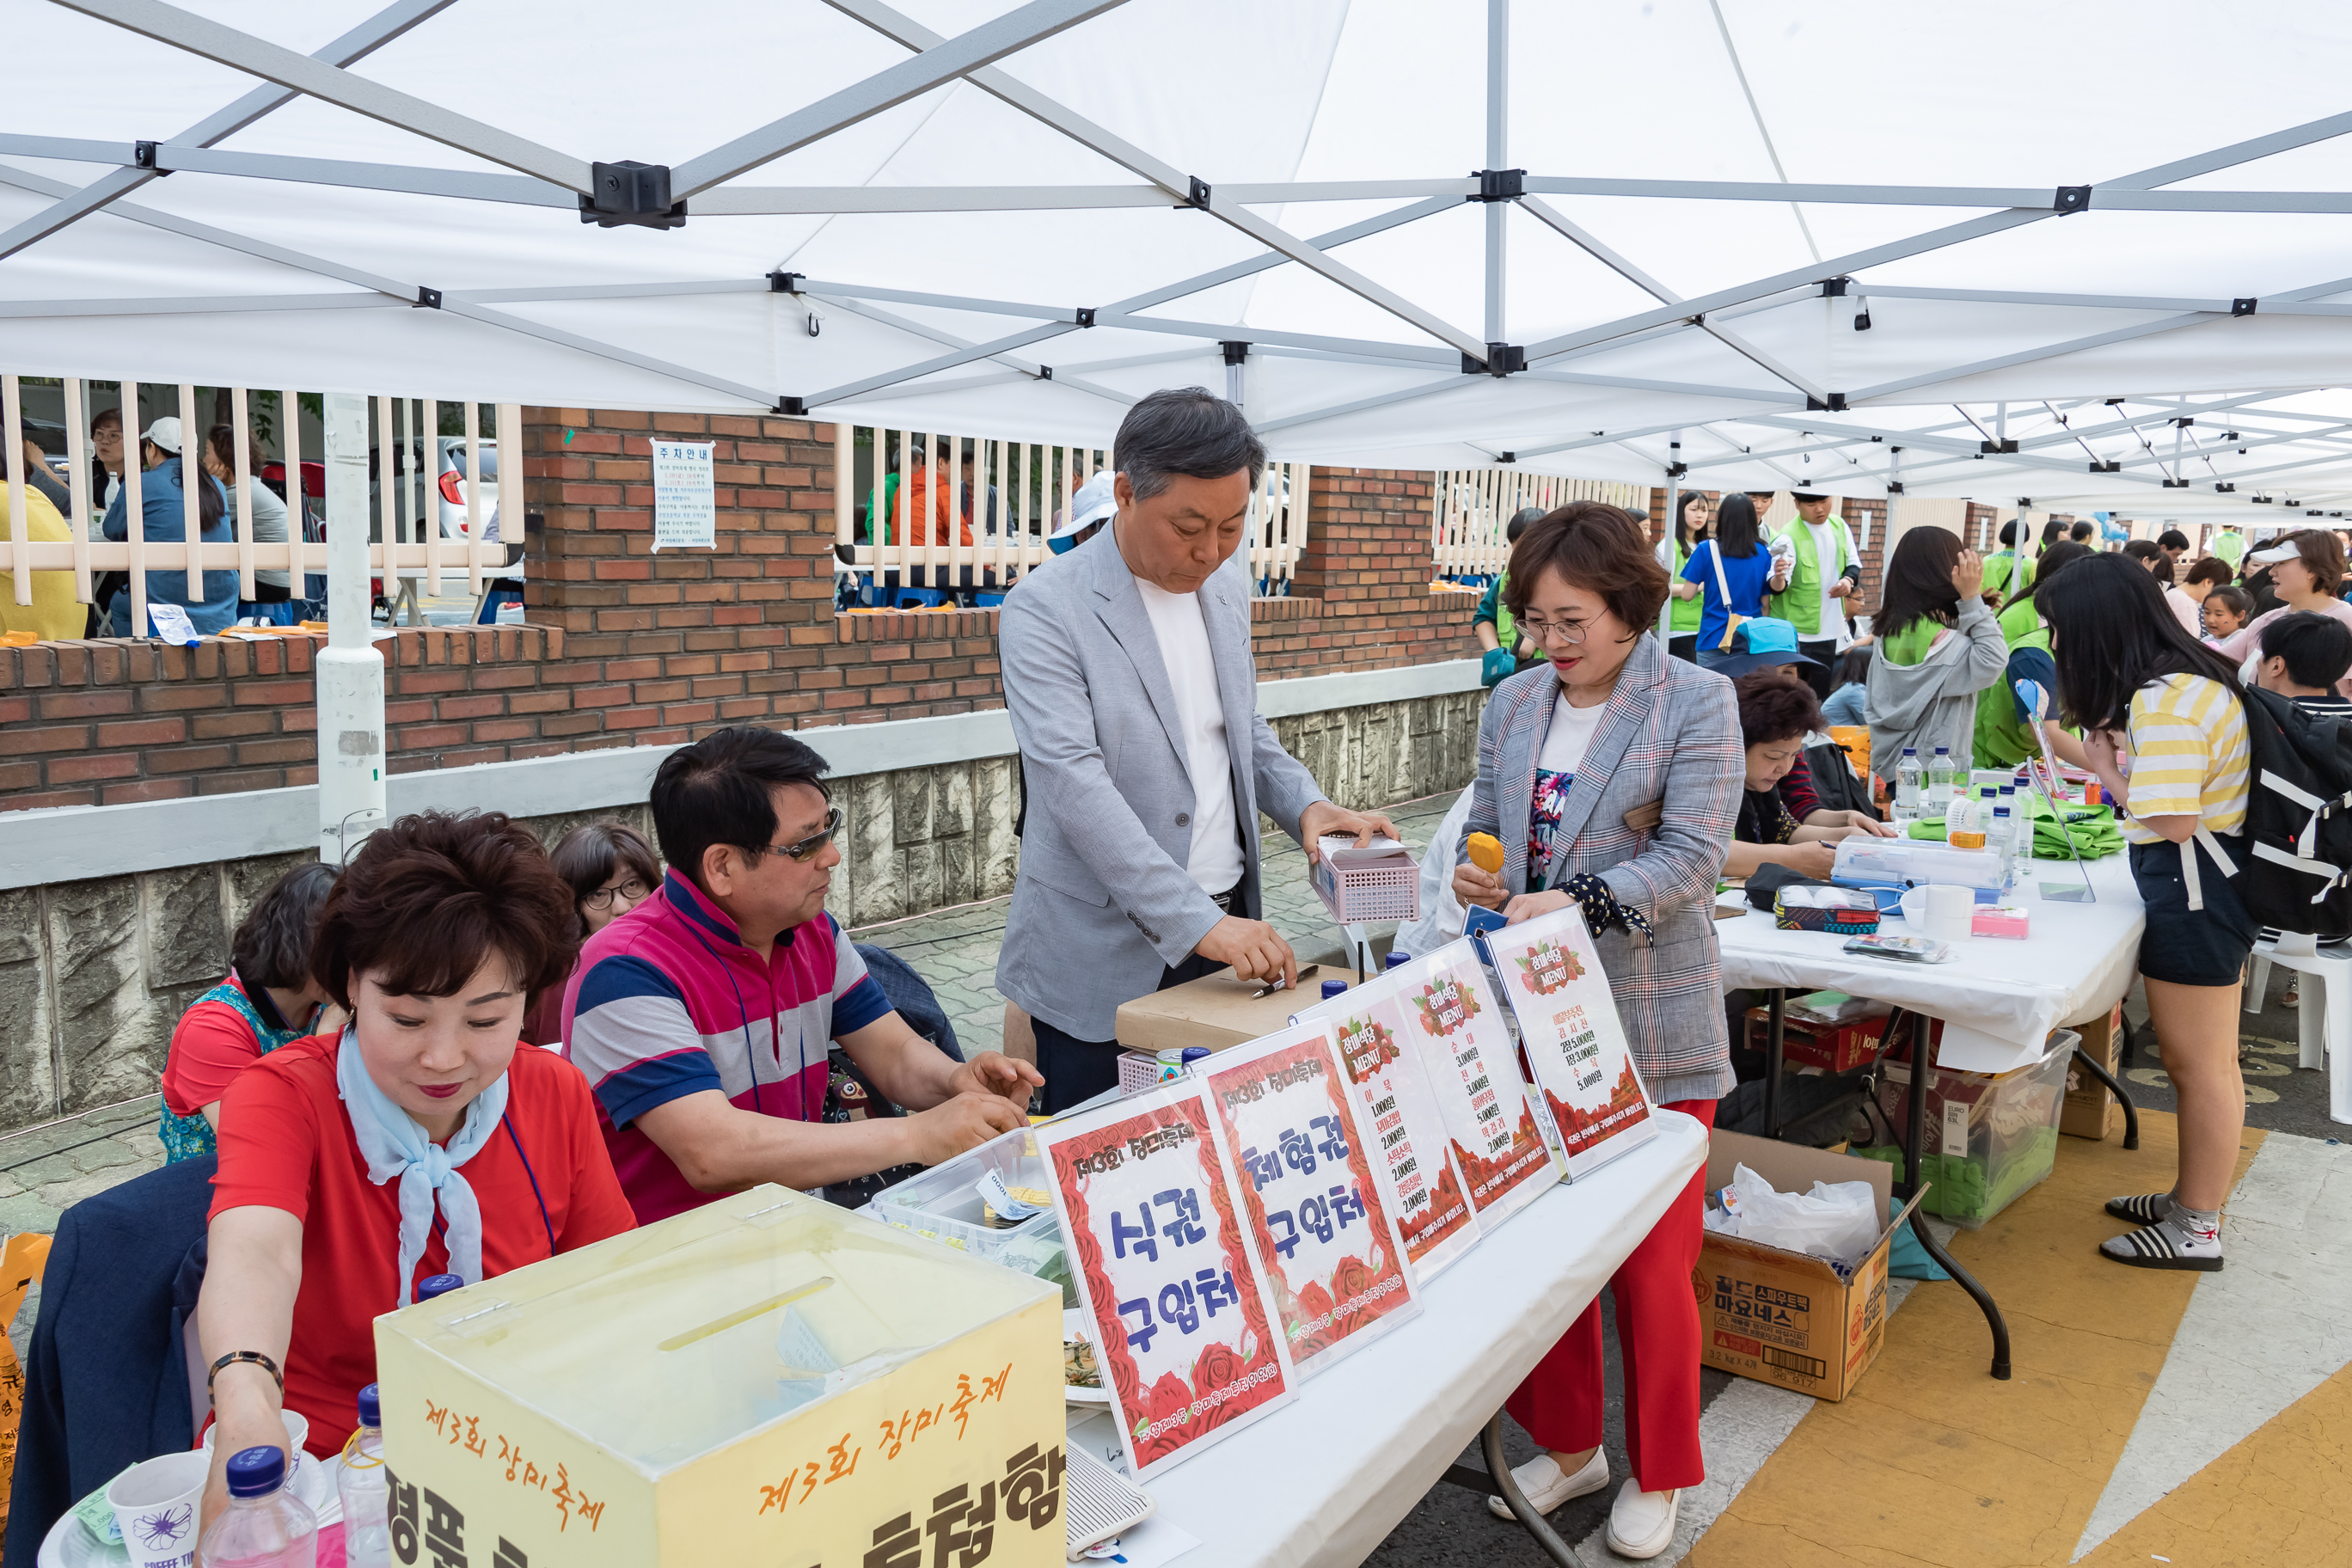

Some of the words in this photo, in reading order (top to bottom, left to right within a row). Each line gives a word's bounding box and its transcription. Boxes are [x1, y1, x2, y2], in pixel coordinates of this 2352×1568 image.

[1530, 947, 1562, 971] 장미식당
[1540, 965, 1567, 987] MENU
[1427, 983, 1459, 1010] 장미식당
[1437, 1003, 1464, 1028] MENU
[1341, 1025, 1375, 1055] 장미식당
[1352, 1046, 1381, 1075] MENU
[1455, 1046, 1479, 1068] 3,000원
[1221, 1077, 1265, 1110] 제3회
[1265, 1058, 1324, 1093] 장미축제
[1466, 1074, 1491, 1097] 3,000원
[1577, 1069, 1603, 1092] 5,000원
[1370, 1094, 1397, 1118] 1,000원
[1476, 1102, 1500, 1125] 5,000원
[1947, 1106, 1964, 1114] EURO
[1072, 1143, 1124, 1180] 제3회
[1127, 1122, 1196, 1161] 장미축제
[1381, 1125, 1407, 1150] 2,000원
[1487, 1130, 1510, 1154] 2,000원
[1241, 1115, 1350, 1191] 체험권
[1387, 1140, 1413, 1167] 소떡소떡
[1392, 1156, 1418, 1182] 2,000원
[1402, 1187, 1429, 1214] 2,000원
[1111, 1187, 1207, 1262] 식권
[1266, 1185, 1365, 1259] 구입처
[1404, 1233, 1421, 1252] 부에서
[1715, 1275, 1753, 1300] 골드
[1757, 1287, 1808, 1311] 스파우트팩
[1118, 1267, 1239, 1353] 구입처
[1714, 1293, 1792, 1328] 마요네스
[1290, 1312, 1332, 1344] 자양제3동
[1724, 1353, 1736, 1364] kg
[1744, 1359, 1758, 1370] 4개
[1773, 1371, 1787, 1381] 96
[1792, 1377, 1814, 1387] 917
[759, 1433, 861, 1516] 제3회
[878, 1362, 1013, 1461] 장미축제
[1137, 1407, 1188, 1444] 자양제3동
[426, 1399, 487, 1459] 제3회
[498, 1434, 605, 1533] 장미축제
